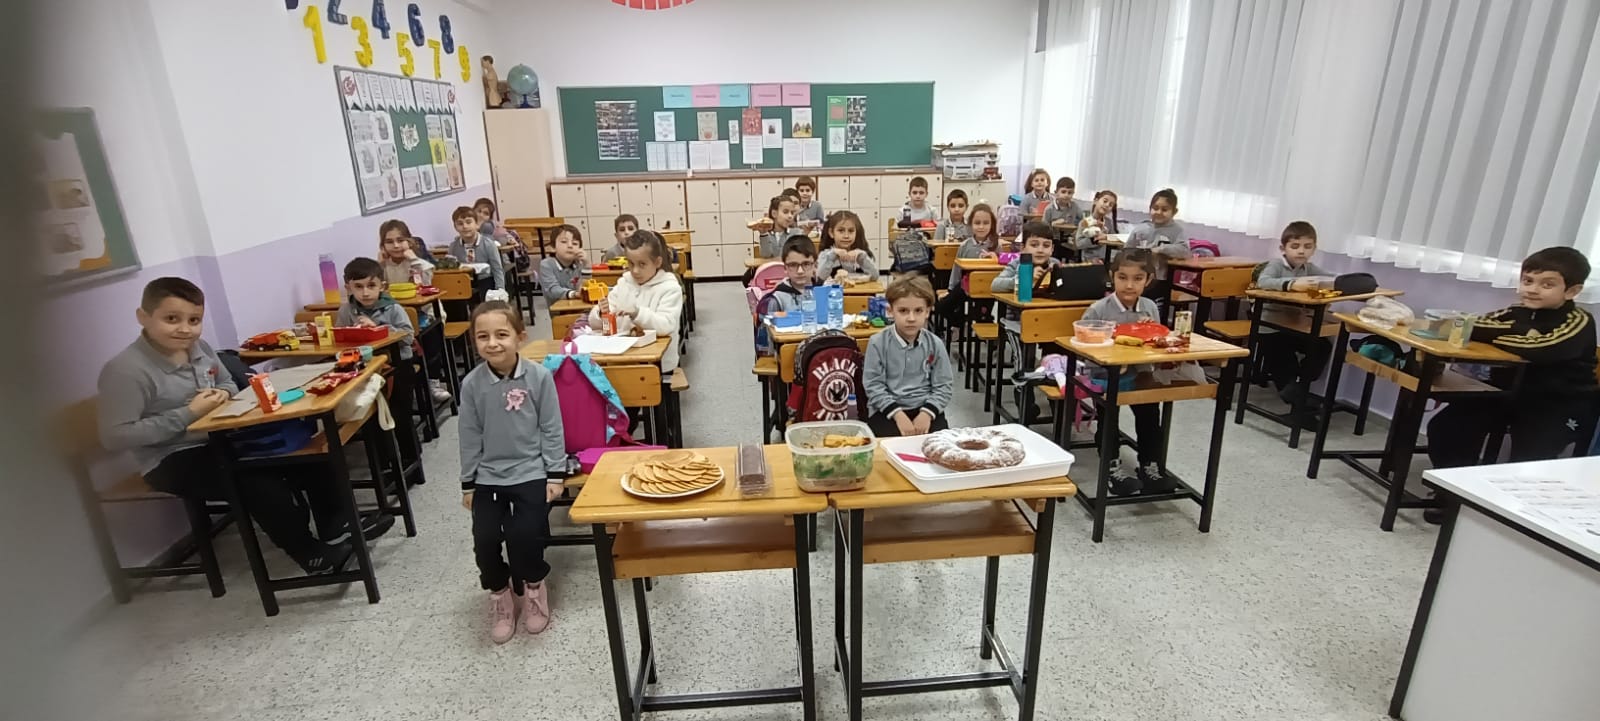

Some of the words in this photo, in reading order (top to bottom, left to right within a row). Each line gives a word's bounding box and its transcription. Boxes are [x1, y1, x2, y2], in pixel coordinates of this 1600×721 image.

[303, 5, 327, 64] 1
[351, 16, 373, 68] 3
[396, 32, 414, 78] 5
[427, 38, 442, 80] 7
[458, 45, 471, 83] 9
[371, 0, 391, 39] 4
[407, 3, 425, 47] 6
[439, 14, 455, 54] 8
[812, 357, 858, 381] BLACK
